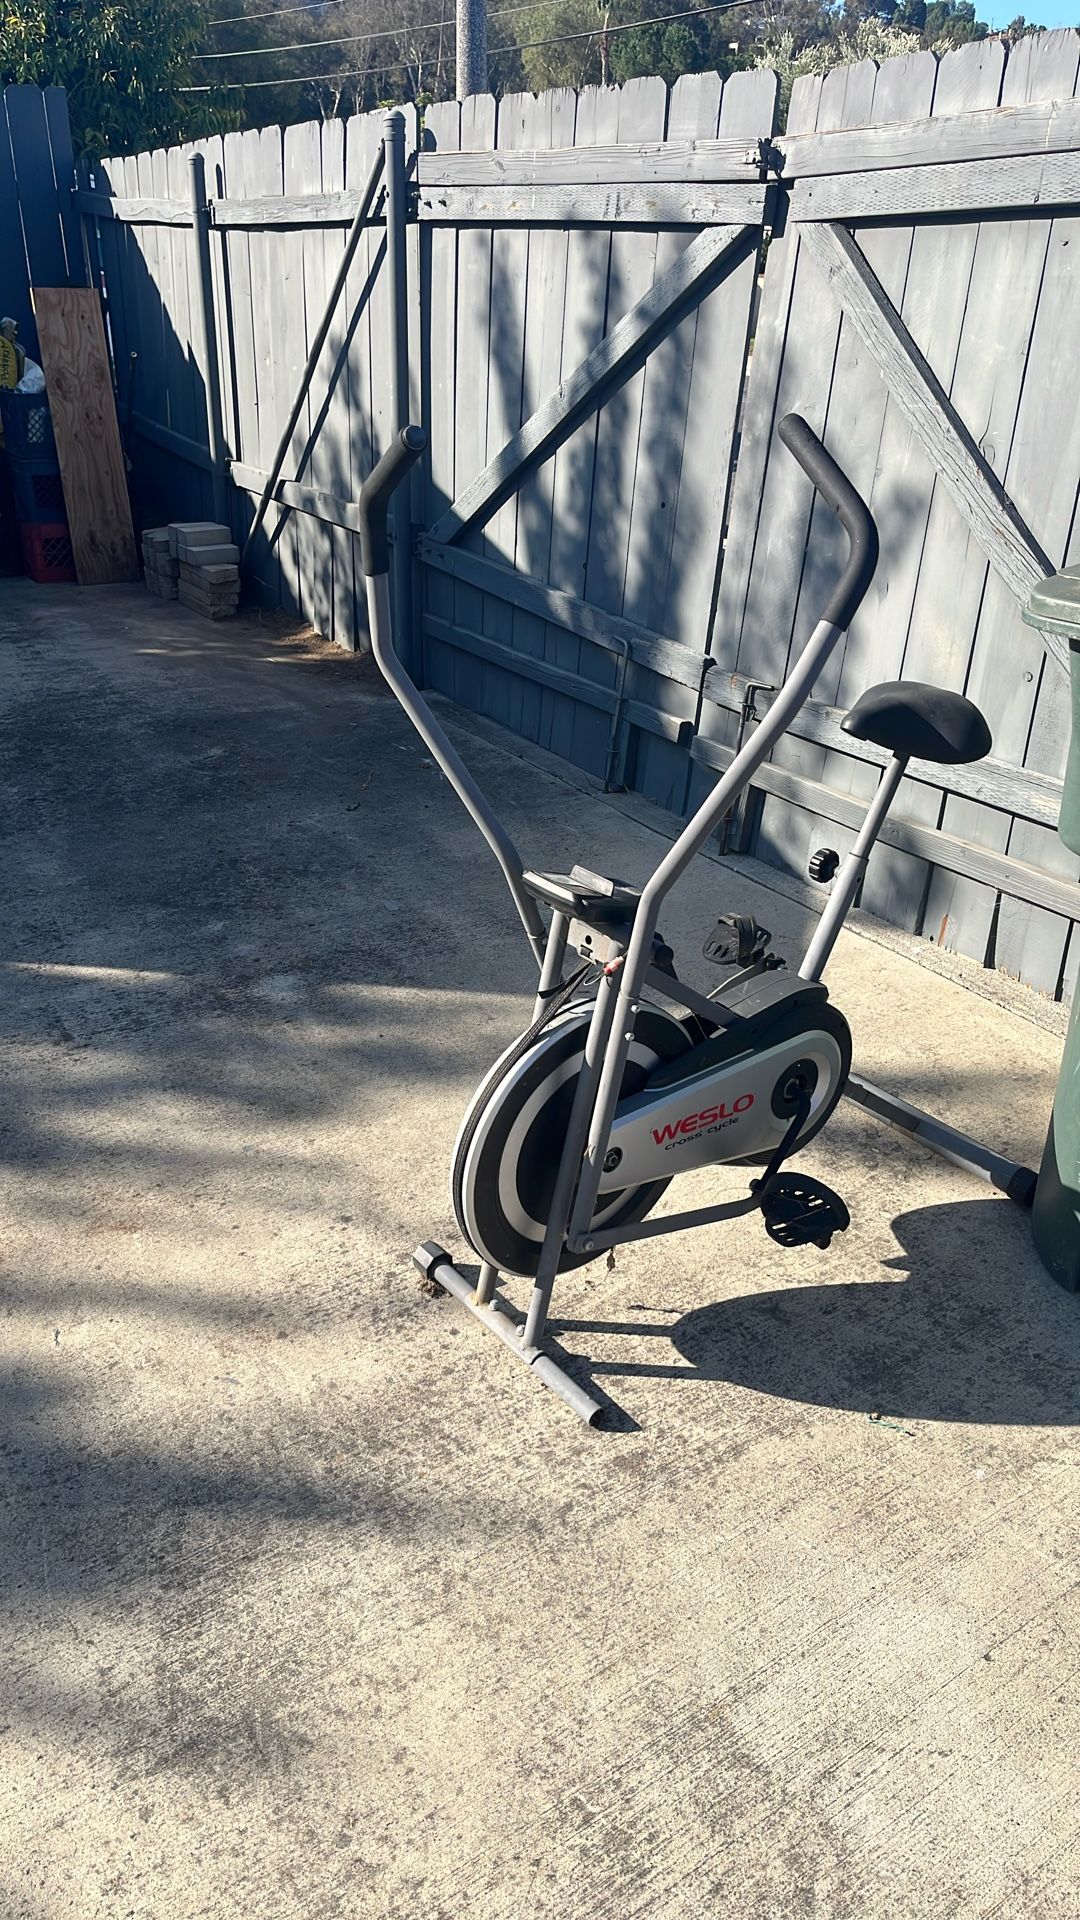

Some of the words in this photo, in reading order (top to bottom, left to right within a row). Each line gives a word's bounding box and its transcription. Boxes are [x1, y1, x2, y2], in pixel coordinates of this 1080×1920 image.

[652, 1093, 755, 1145] WESLO
[664, 1131, 703, 1151] cross
[707, 1117, 739, 1134] cycle
